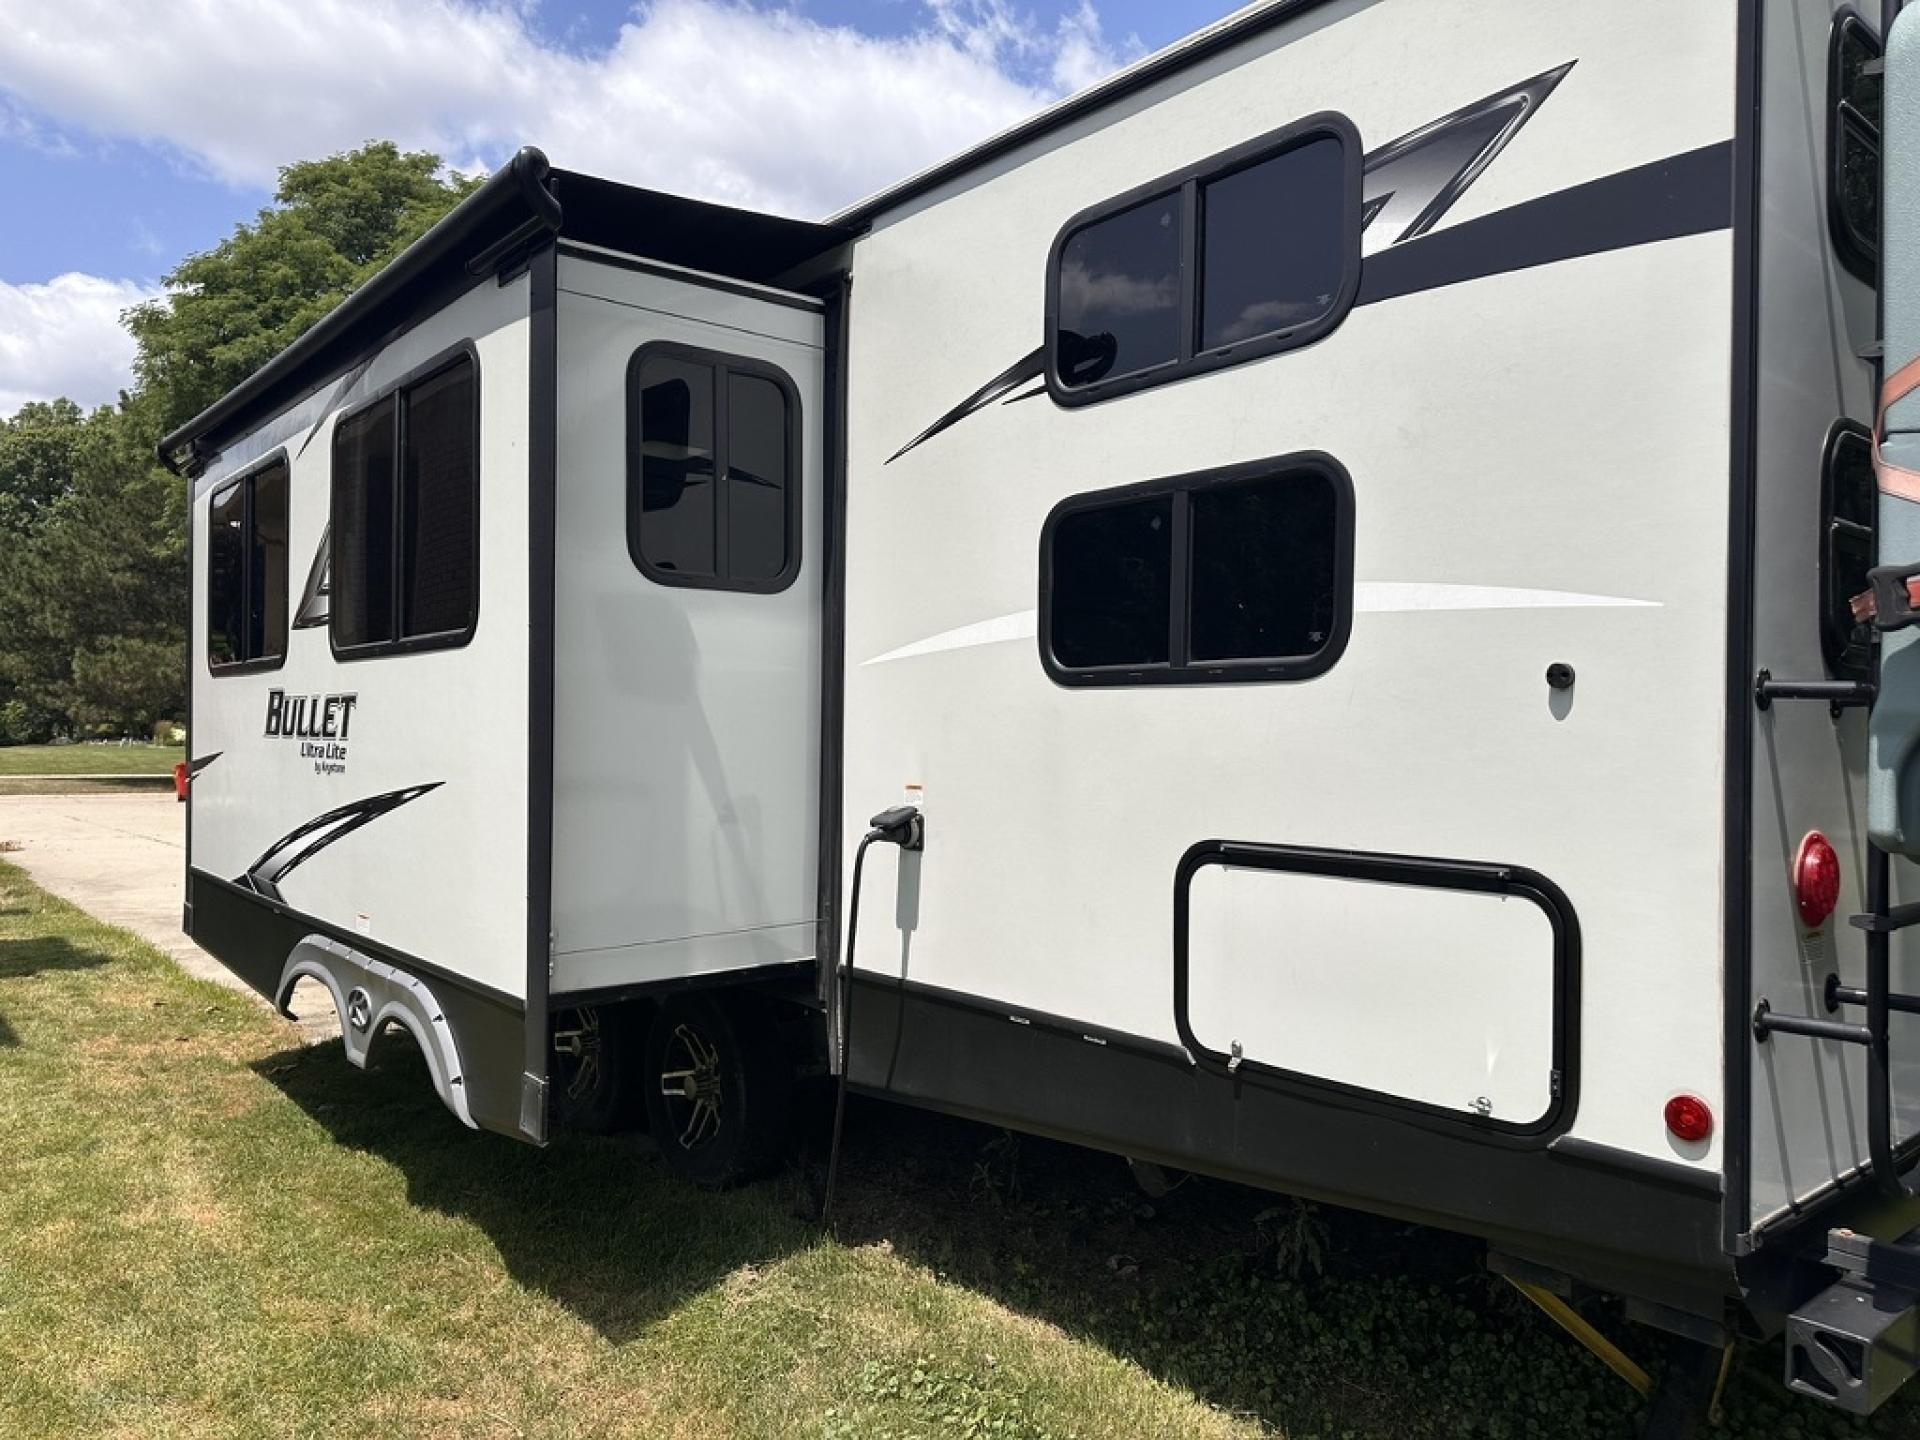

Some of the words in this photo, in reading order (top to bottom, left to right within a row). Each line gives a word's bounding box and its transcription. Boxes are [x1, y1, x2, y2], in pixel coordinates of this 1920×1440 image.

[264, 689, 357, 740] BULLET
[301, 742, 325, 759] Ultra
[326, 743, 347, 760] Lite
